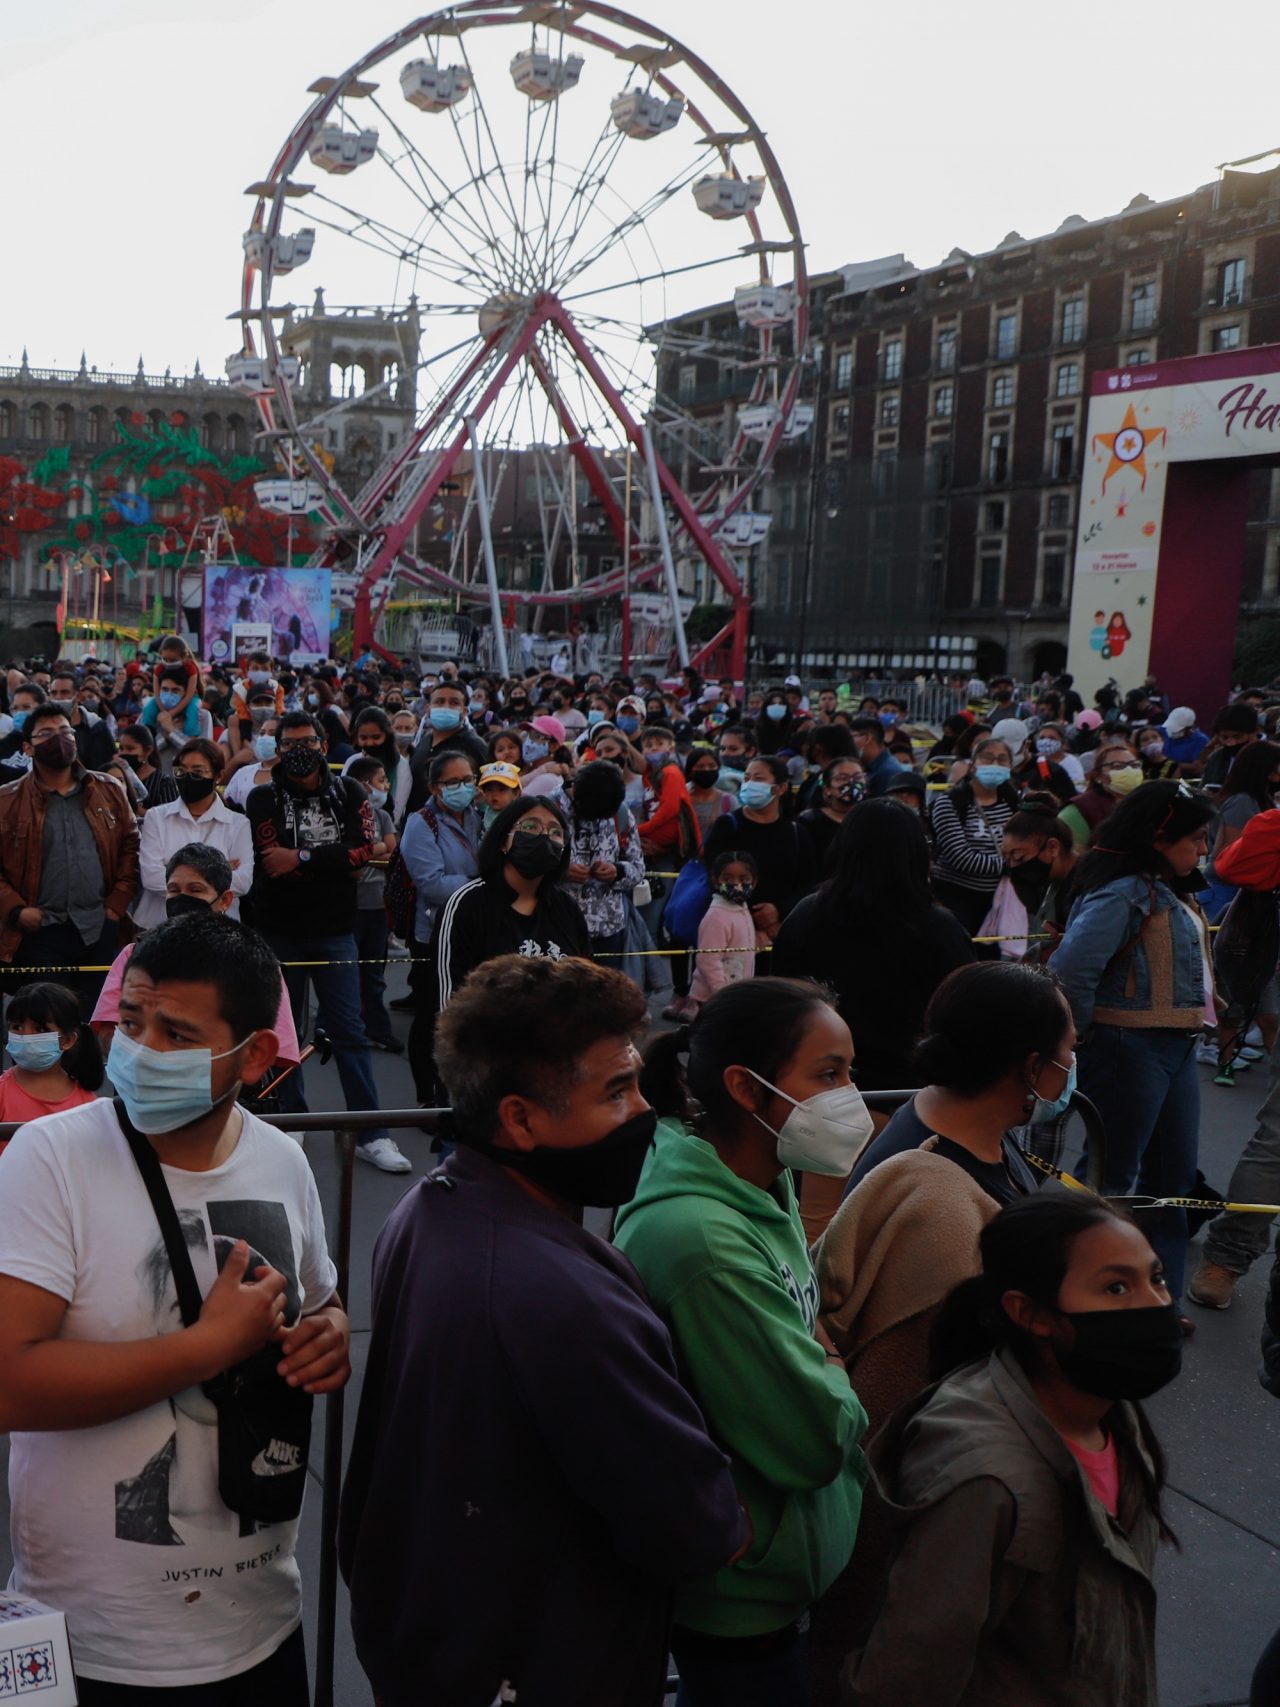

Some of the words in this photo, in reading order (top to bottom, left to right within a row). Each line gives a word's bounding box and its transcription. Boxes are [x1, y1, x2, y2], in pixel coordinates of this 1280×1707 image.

[1218, 383, 1280, 437] Ha
[266, 1438, 300, 1465] NIKE
[161, 1567, 224, 1582] JUSTIN
